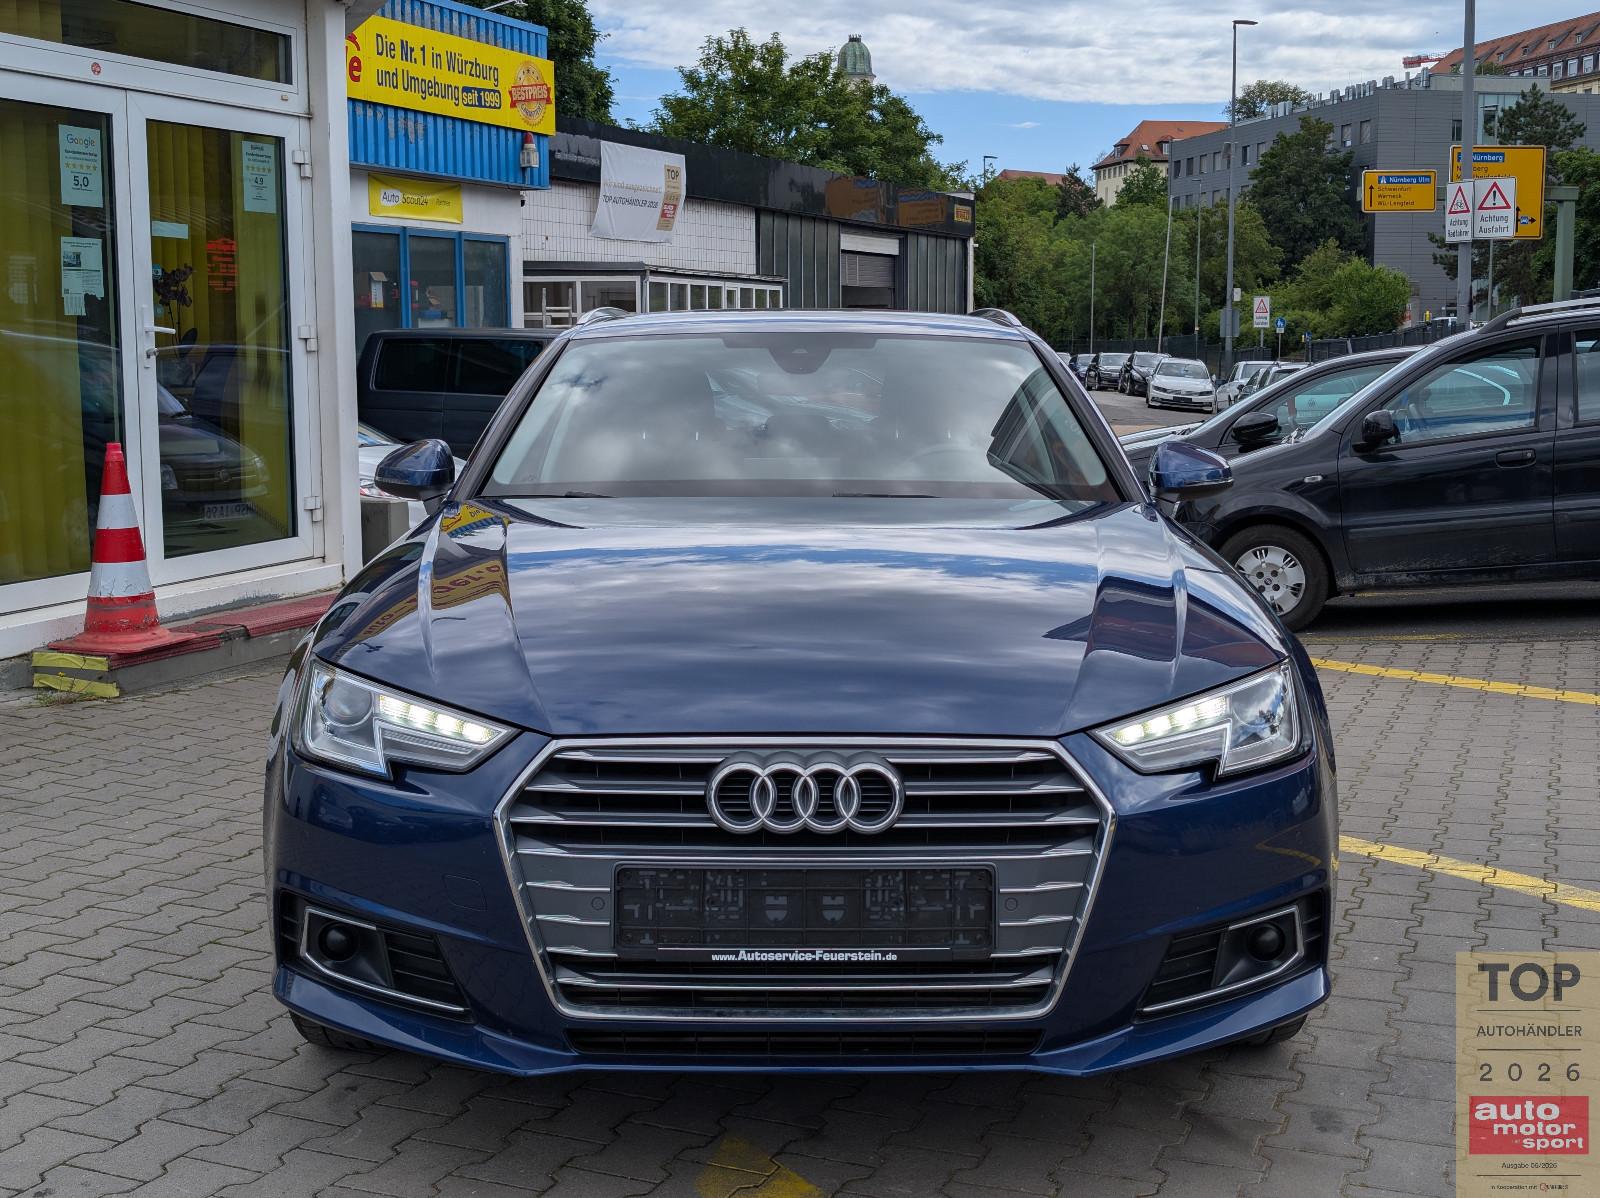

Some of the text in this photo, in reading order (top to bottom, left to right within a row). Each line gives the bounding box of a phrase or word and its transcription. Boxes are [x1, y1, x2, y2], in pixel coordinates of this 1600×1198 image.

[375, 33, 499, 87] Die Nr. 1 in Würzburg
[376, 68, 500, 107] und Umgebung seit 1999
[512, 85, 548, 100] BESTPREIS
[66, 133, 96, 148] Google
[666, 169, 679, 180] TOP
[1389, 175, 1431, 183] Nürnberg Ulm
[73, 175, 89, 189] 5,0
[382, 191, 400, 204] Auto
[602, 194, 613, 203] TOP
[1479, 214, 1509, 223] Achtung
[1478, 225, 1509, 234] Ausfahrt
[711, 950, 898, 961] www.Autoservice-Feuerstein.de
